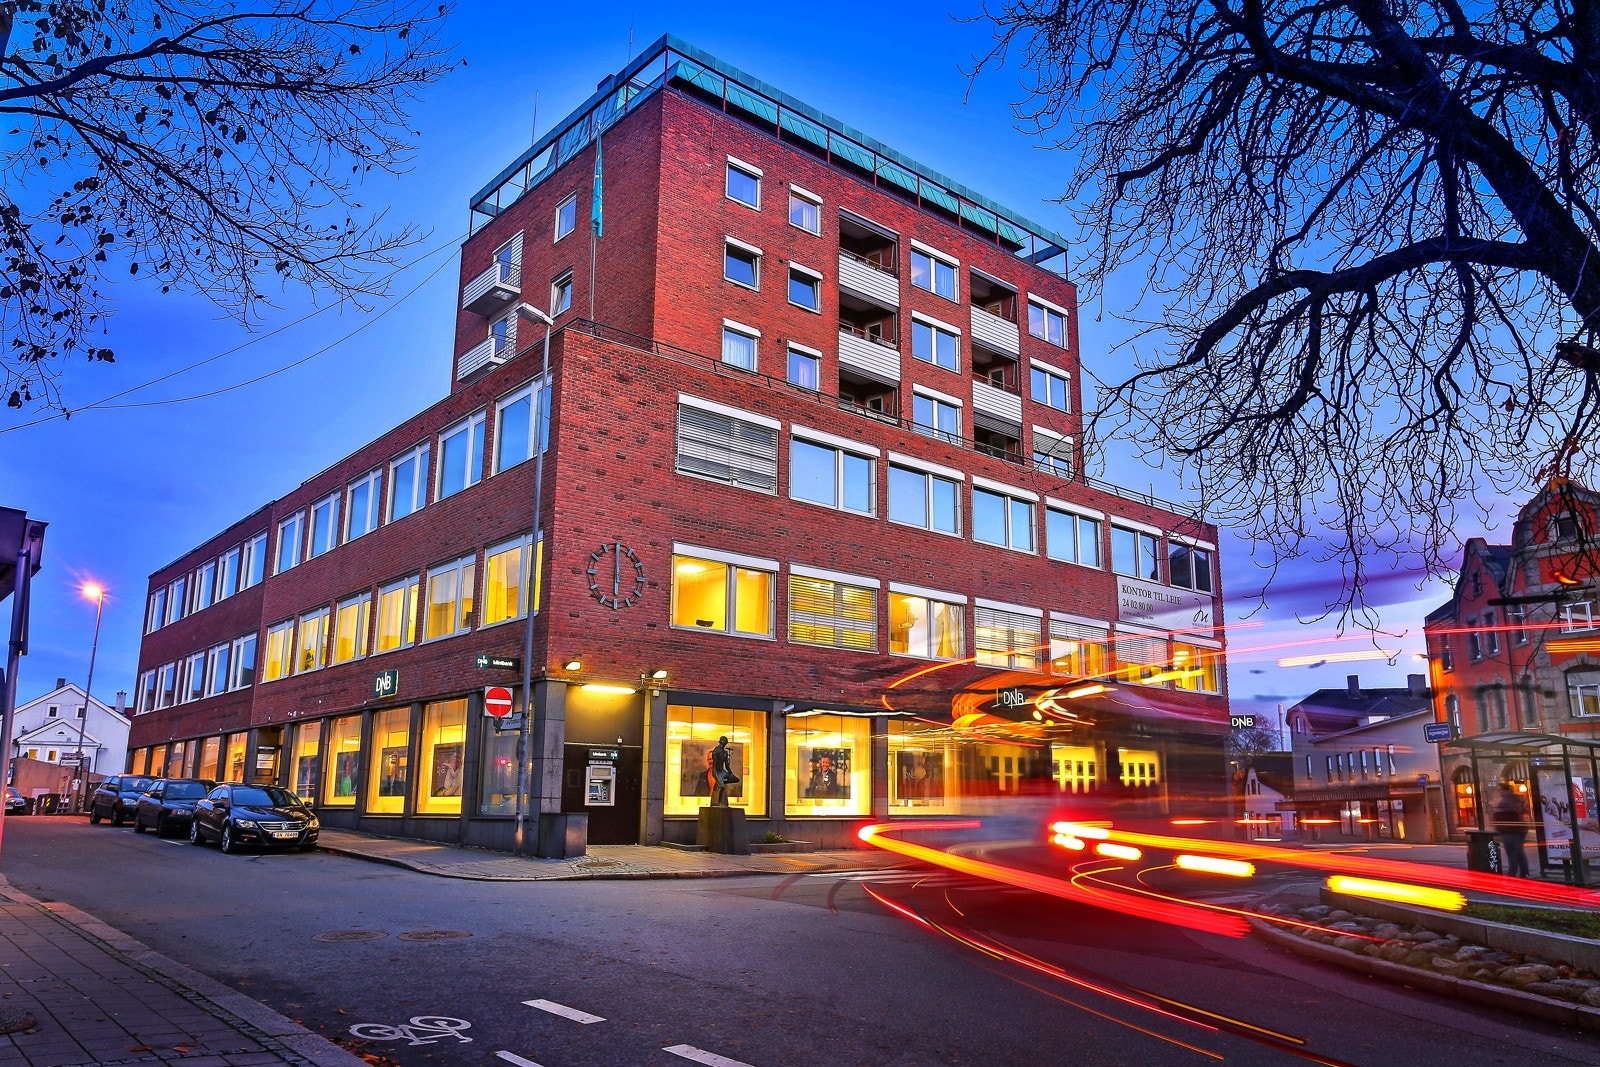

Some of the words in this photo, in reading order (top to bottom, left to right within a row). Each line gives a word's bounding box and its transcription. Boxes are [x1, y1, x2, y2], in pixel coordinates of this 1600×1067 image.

[1122, 584, 1153, 599] KONTOR
[1153, 591, 1165, 602] TIL
[1165, 594, 1182, 605] LEIE
[1122, 598, 1129, 607] 24
[1130, 600, 1137, 609] 02
[1138, 601, 1145, 611] 80
[1145, 603, 1153, 613] 00
[477, 655, 489, 668] DNB
[492, 659, 514, 667] Minibank
[375, 671, 392, 696] DNB
[1003, 687, 1025, 709] DNB
[1231, 714, 1254, 730] DNB
